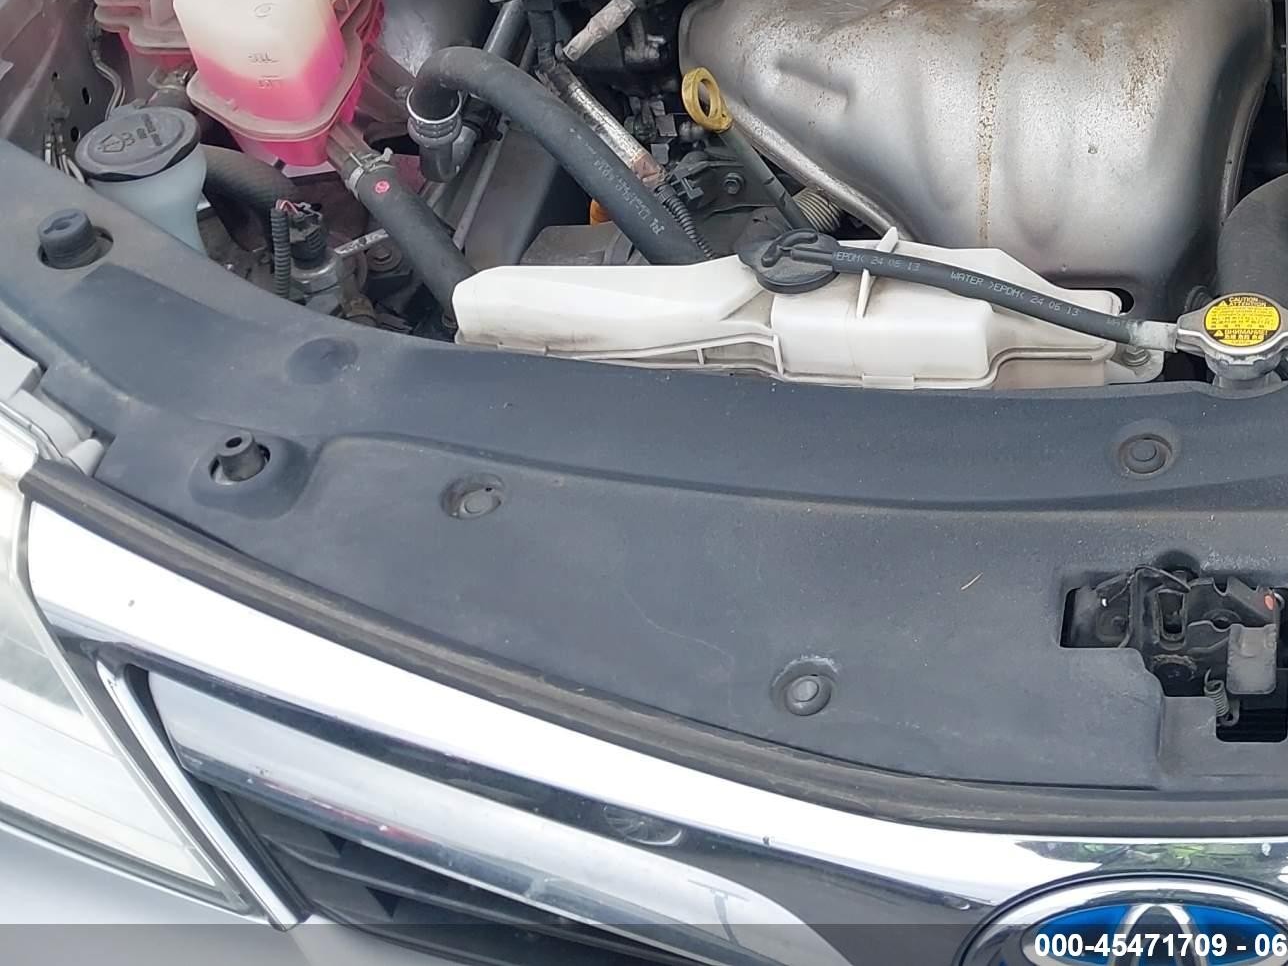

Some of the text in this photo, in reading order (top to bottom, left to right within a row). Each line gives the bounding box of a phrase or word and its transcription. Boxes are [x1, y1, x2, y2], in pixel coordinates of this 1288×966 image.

[951, 271, 984, 285] WATER
[1030, 295, 1044, 306] 24
[1049, 300, 1062, 312] 06
[1066, 306, 1081, 317] 13
